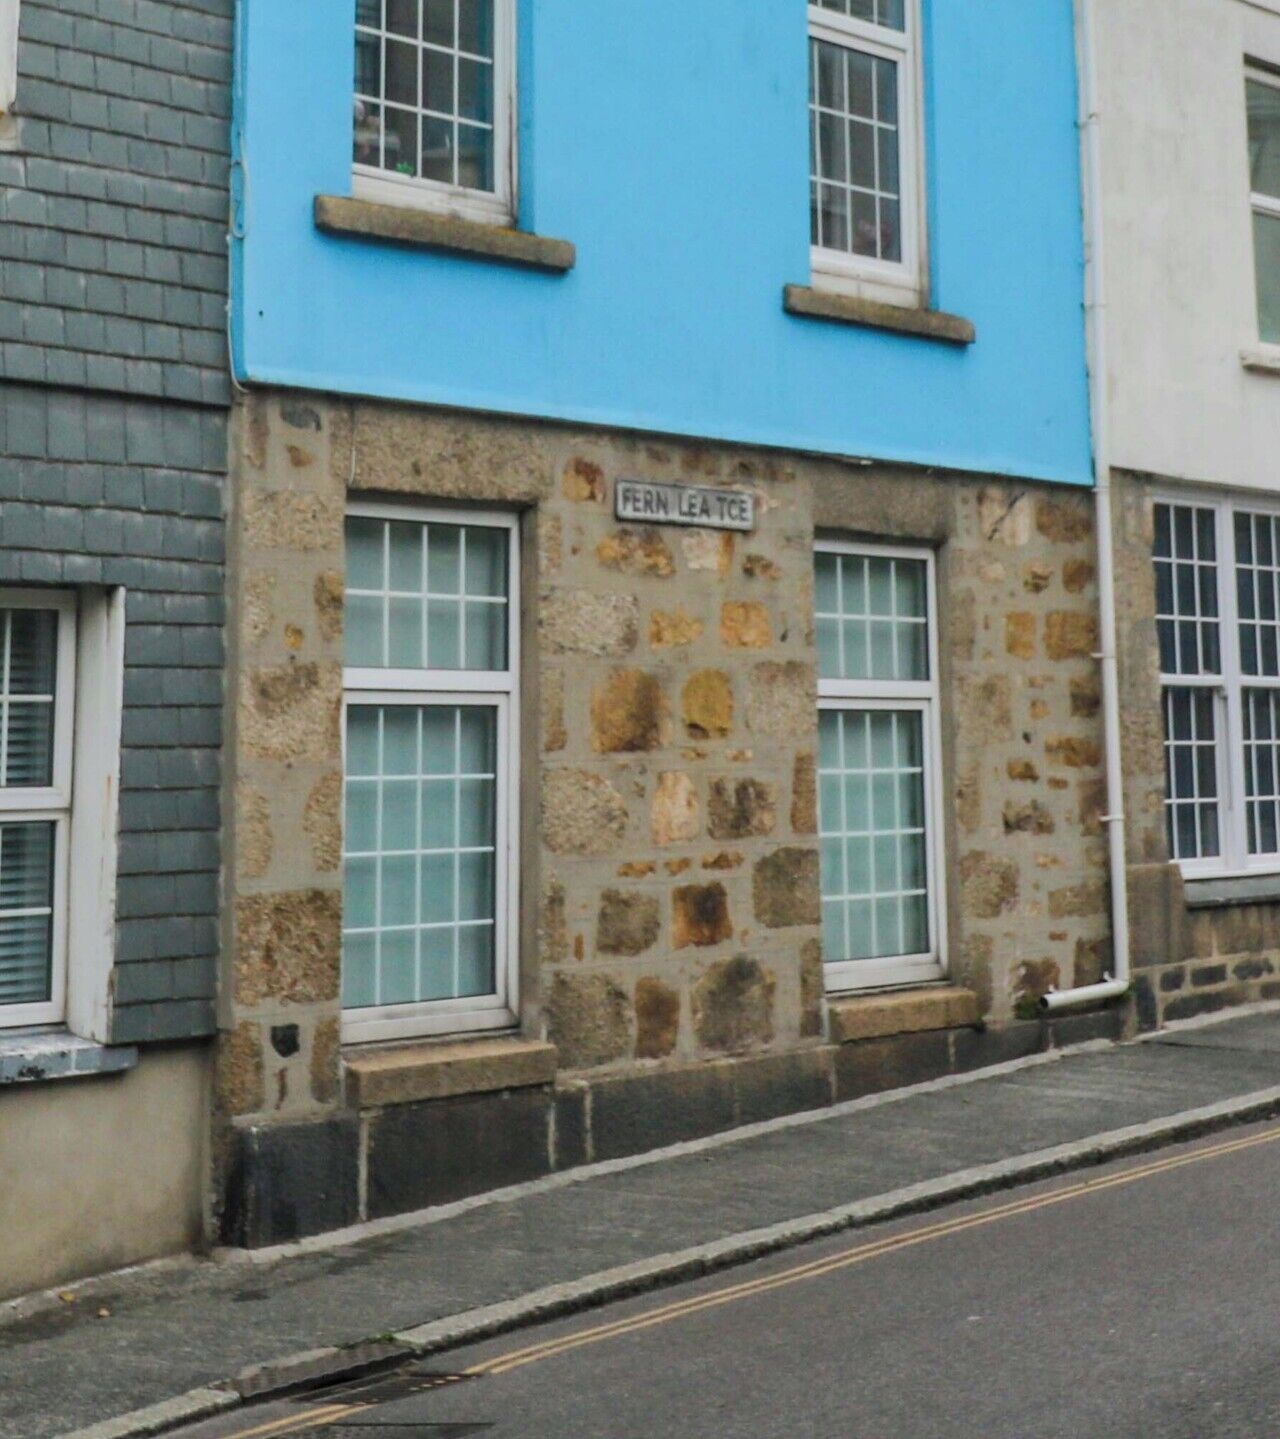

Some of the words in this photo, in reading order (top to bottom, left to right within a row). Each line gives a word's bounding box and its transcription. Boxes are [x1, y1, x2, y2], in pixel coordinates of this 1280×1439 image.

[622, 487, 669, 515] FERN
[678, 492, 710, 518] LEA
[715, 495, 749, 521] TCE
